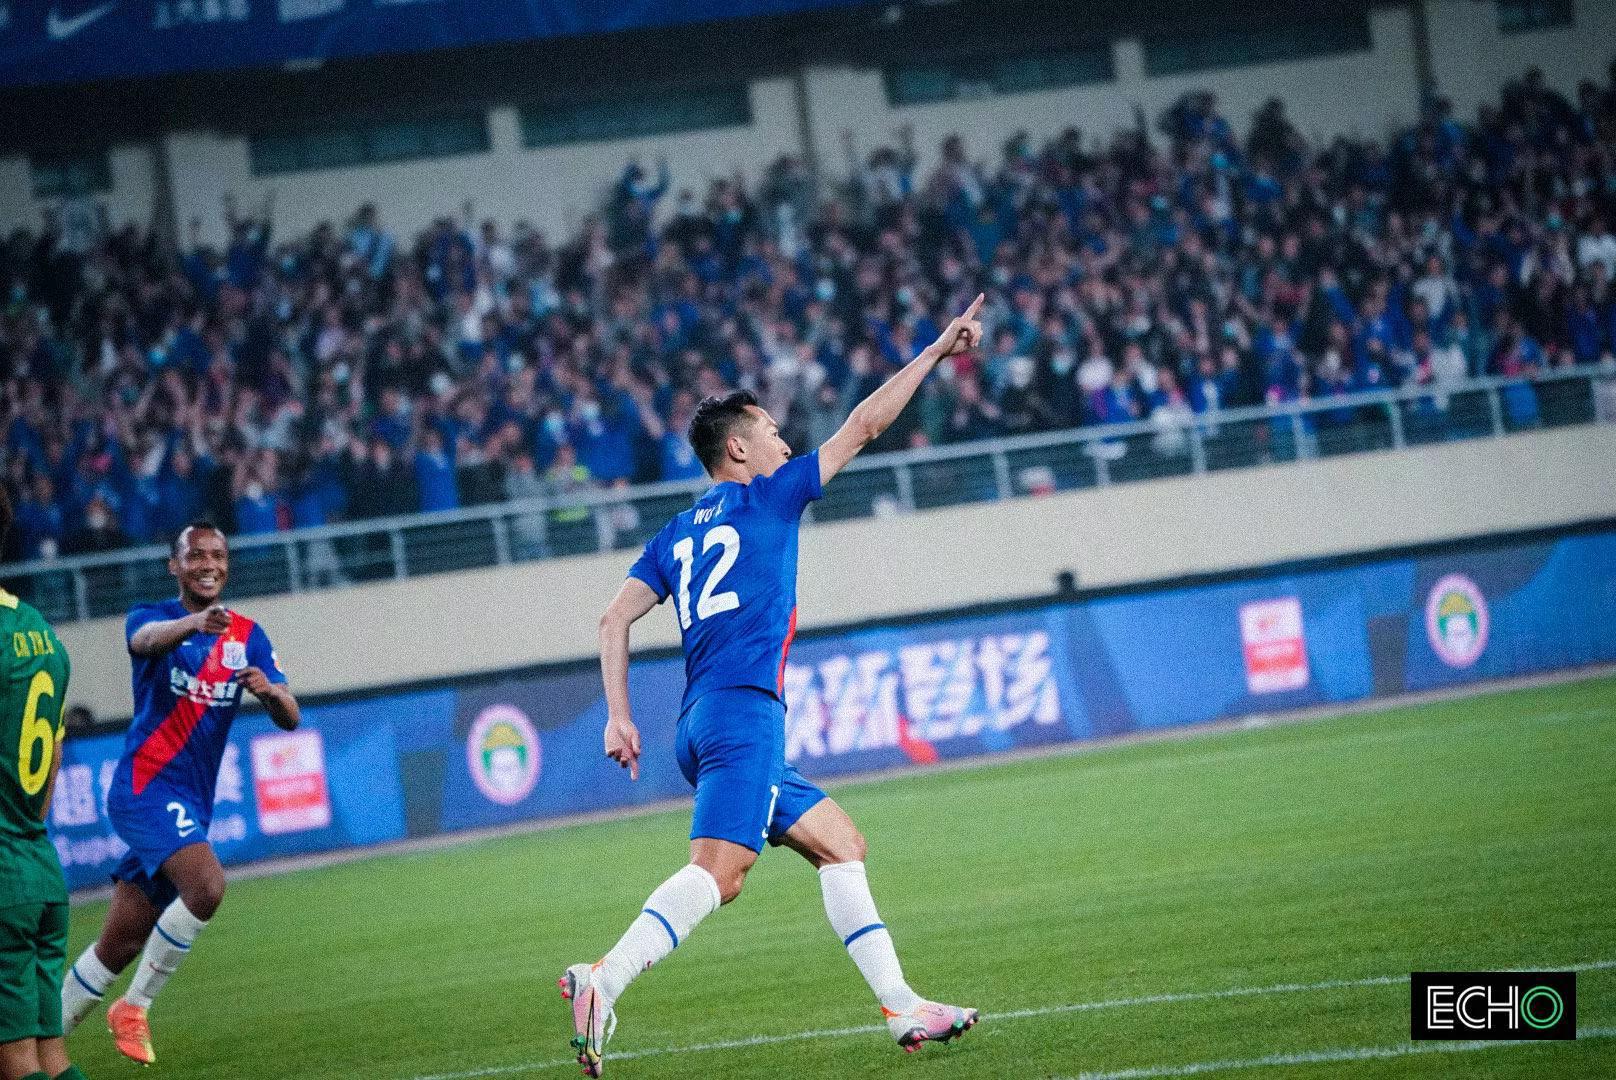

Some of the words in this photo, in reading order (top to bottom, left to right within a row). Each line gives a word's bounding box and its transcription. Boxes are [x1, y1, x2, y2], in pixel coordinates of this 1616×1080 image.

[673, 525, 740, 630] 12
[19, 670, 54, 795] 6
[166, 801, 195, 829] 2
